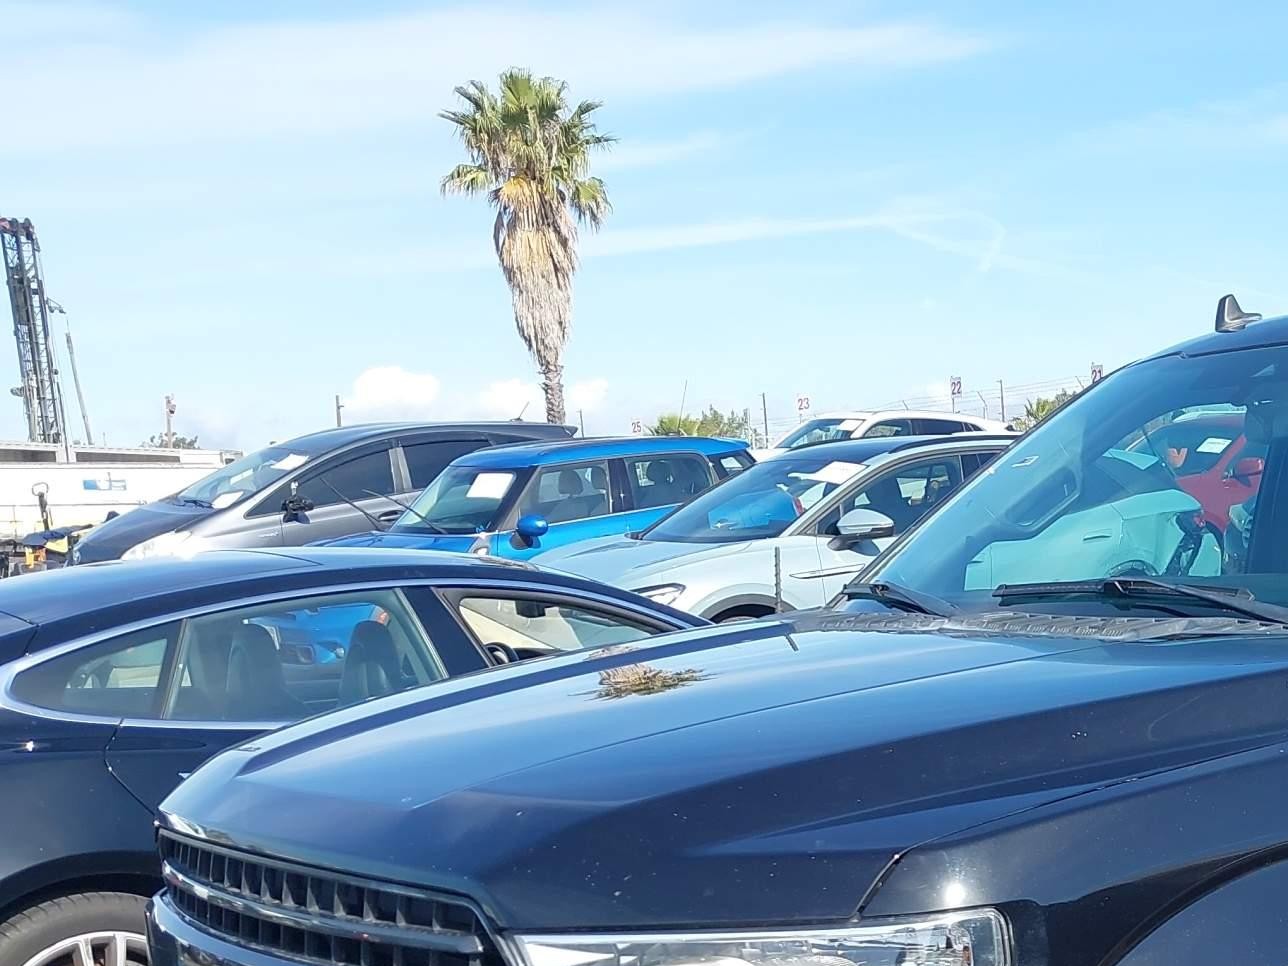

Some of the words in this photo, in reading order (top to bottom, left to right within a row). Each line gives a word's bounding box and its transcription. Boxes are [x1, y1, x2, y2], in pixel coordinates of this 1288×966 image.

[951, 380, 962, 395] 22
[797, 397, 810, 410] 23
[631, 421, 642, 433] 25
